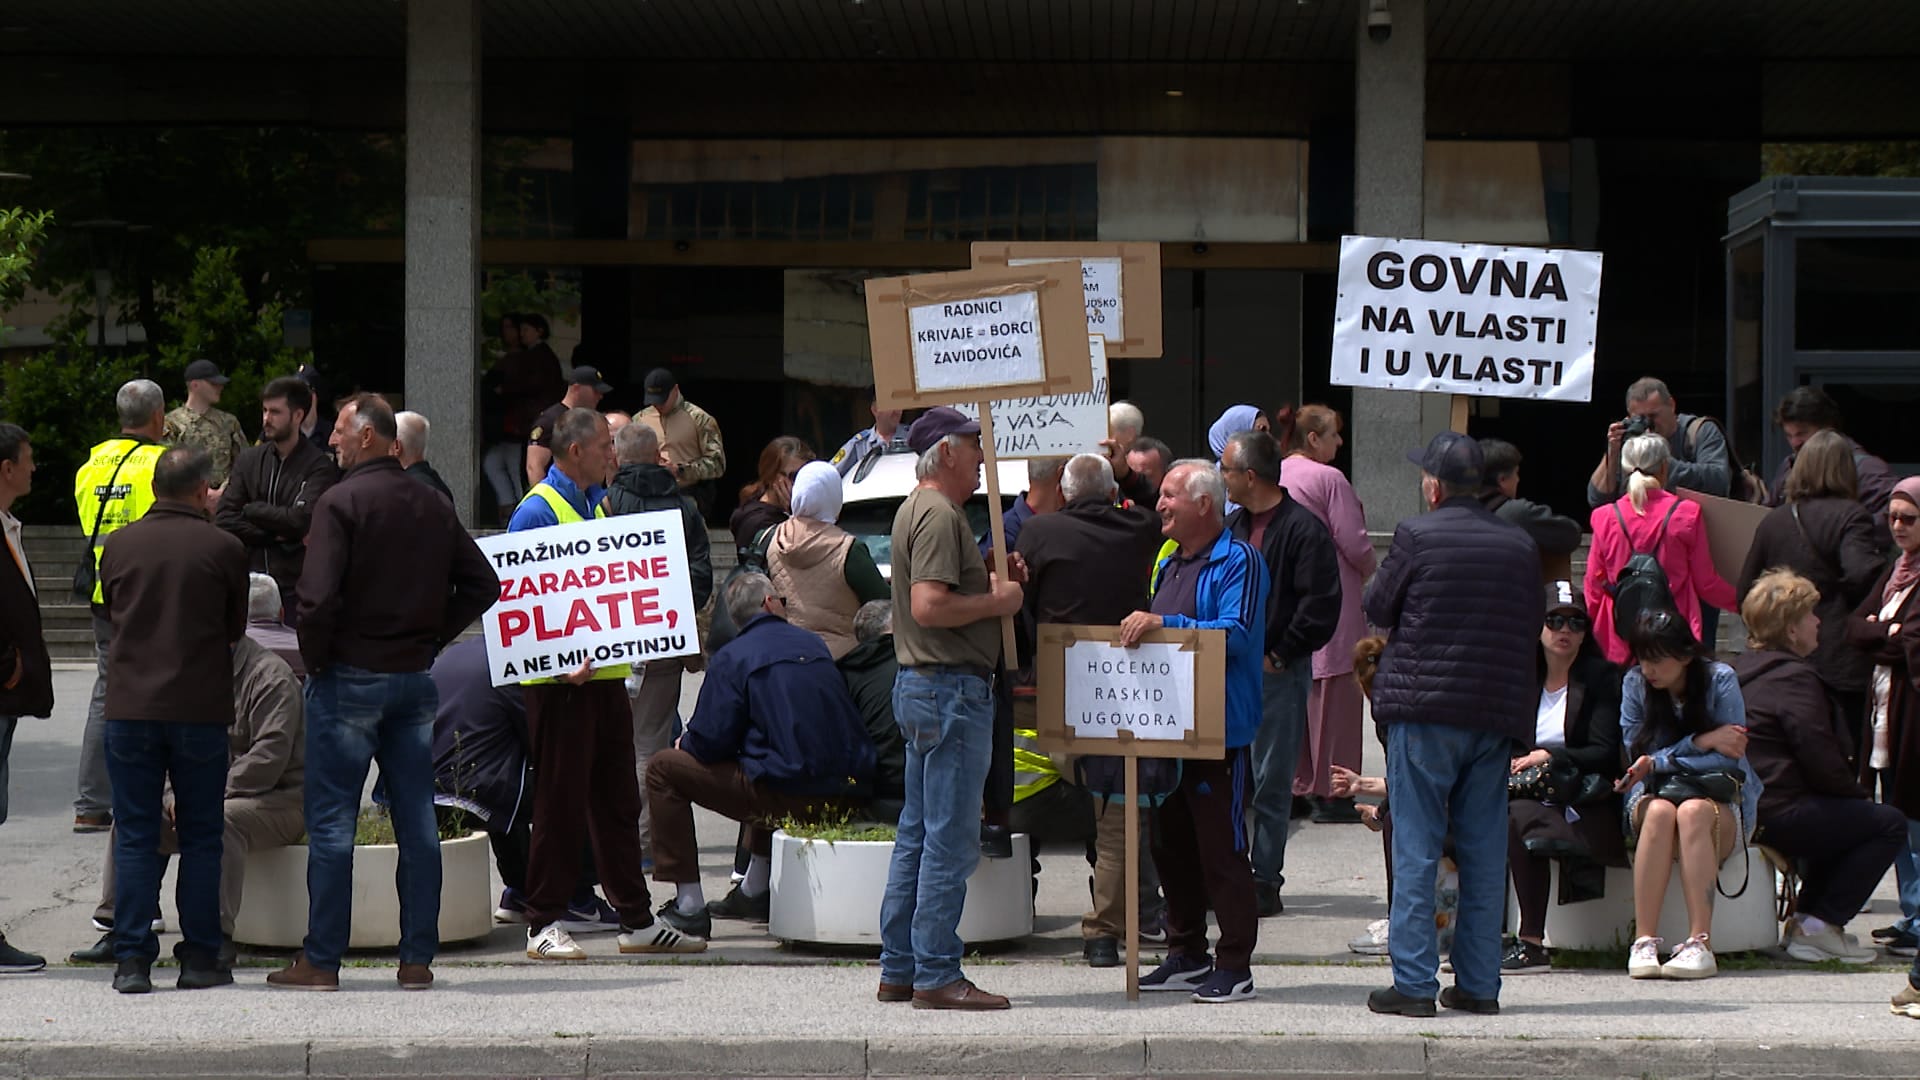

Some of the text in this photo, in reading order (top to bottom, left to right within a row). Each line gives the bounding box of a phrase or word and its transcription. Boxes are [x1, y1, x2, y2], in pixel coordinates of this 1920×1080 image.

[1367, 251, 1568, 301] GOVNA
[944, 300, 1002, 317] RADNICI
[918, 327, 974, 343] KRIVAJE
[990, 321, 1033, 336] BORCI
[1361, 305, 1567, 344] NA VLASTI
[934, 344, 1022, 365] ZAVIDOVIĆA
[1360, 347, 1563, 386] I U VLASTI
[1007, 409, 1074, 431] VAŠA
[493, 529, 667, 568] TRAŽIMO SVOJE
[498, 556, 670, 602] ZARAĐENE
[497, 587, 679, 648] PLATE,
[503, 634, 686, 678] A NE MILOSTINJU
[1088, 658, 1170, 676] HOĆEMO
[1095, 687, 1163, 702] RASKID
[1082, 712, 1177, 726] UGOVORA
